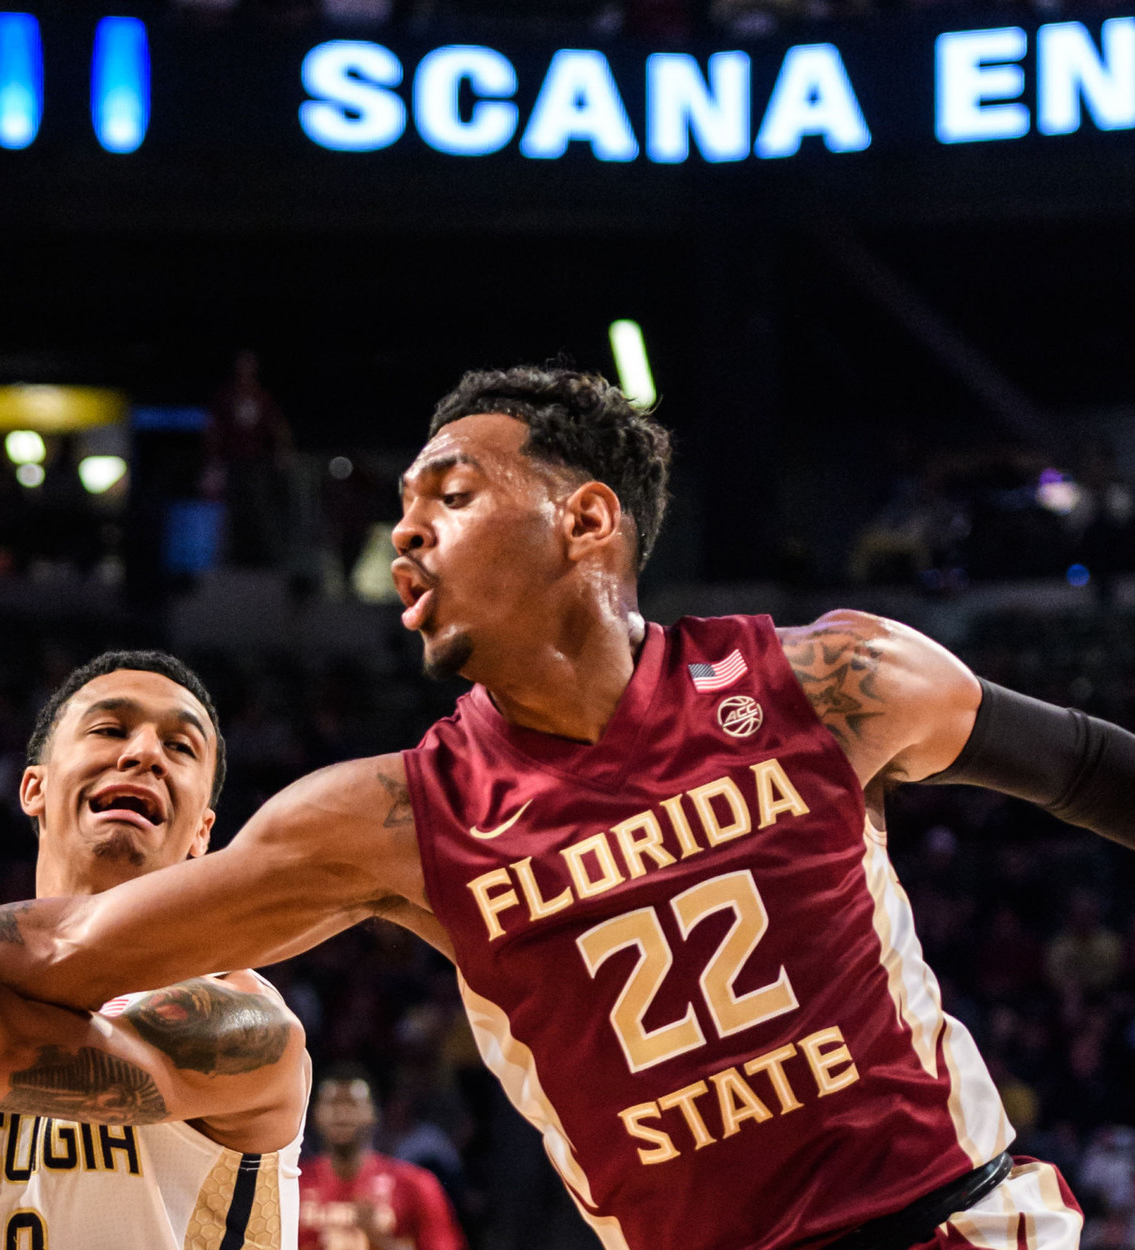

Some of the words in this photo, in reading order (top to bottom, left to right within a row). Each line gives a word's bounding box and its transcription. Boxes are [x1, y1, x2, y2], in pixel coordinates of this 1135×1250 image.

[299, 39, 871, 164] SCANA
[934, 17, 1135, 145] EN
[725, 701, 757, 722] ACC
[467, 758, 809, 941] FLORIDA
[576, 869, 799, 1074] 22
[618, 1026, 859, 1165] STATE
